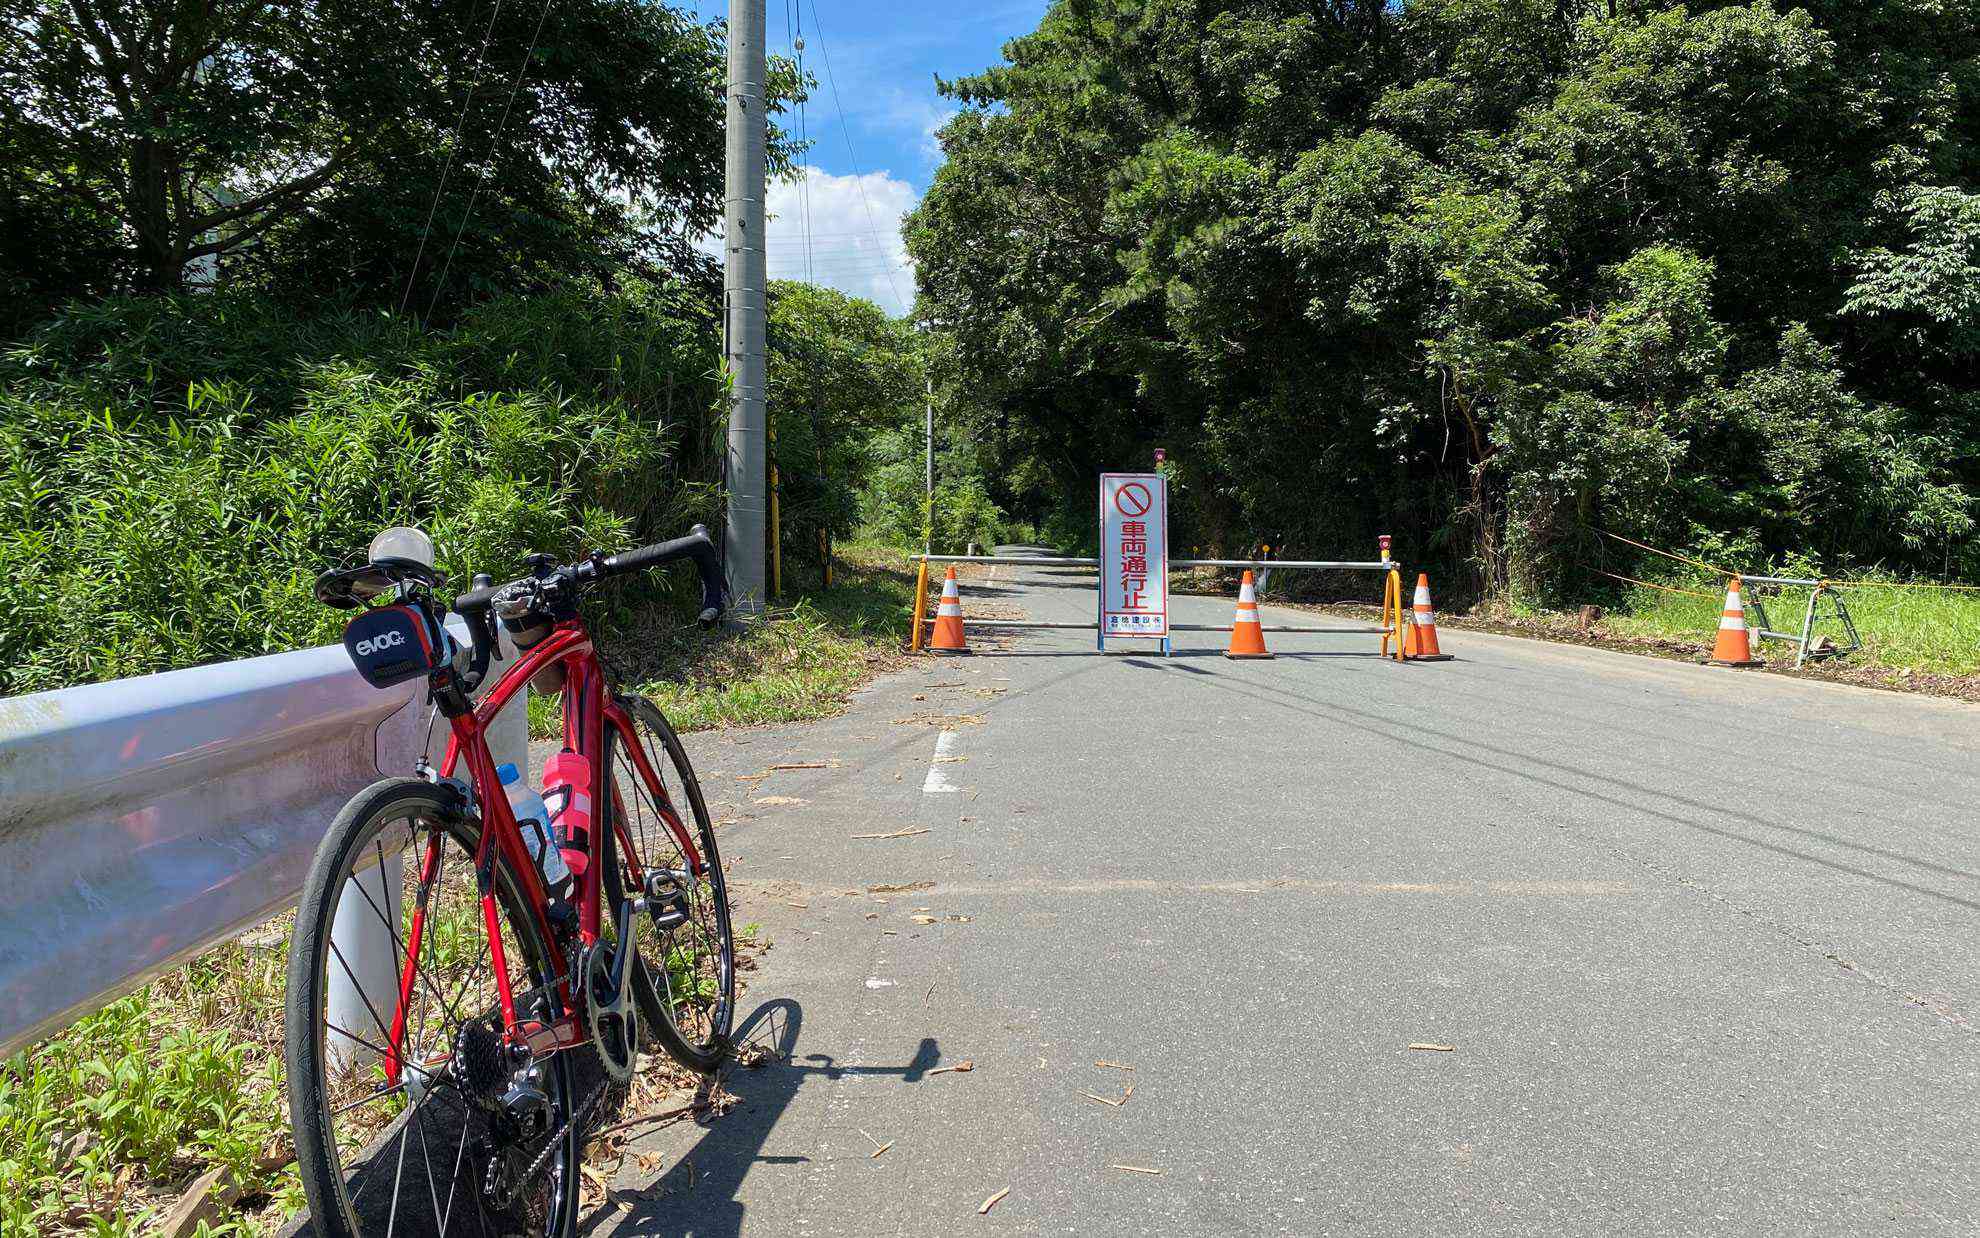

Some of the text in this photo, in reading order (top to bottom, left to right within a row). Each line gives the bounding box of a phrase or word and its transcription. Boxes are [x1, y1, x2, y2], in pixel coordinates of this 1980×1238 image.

[1120, 521, 1148, 608] 車両通行止
